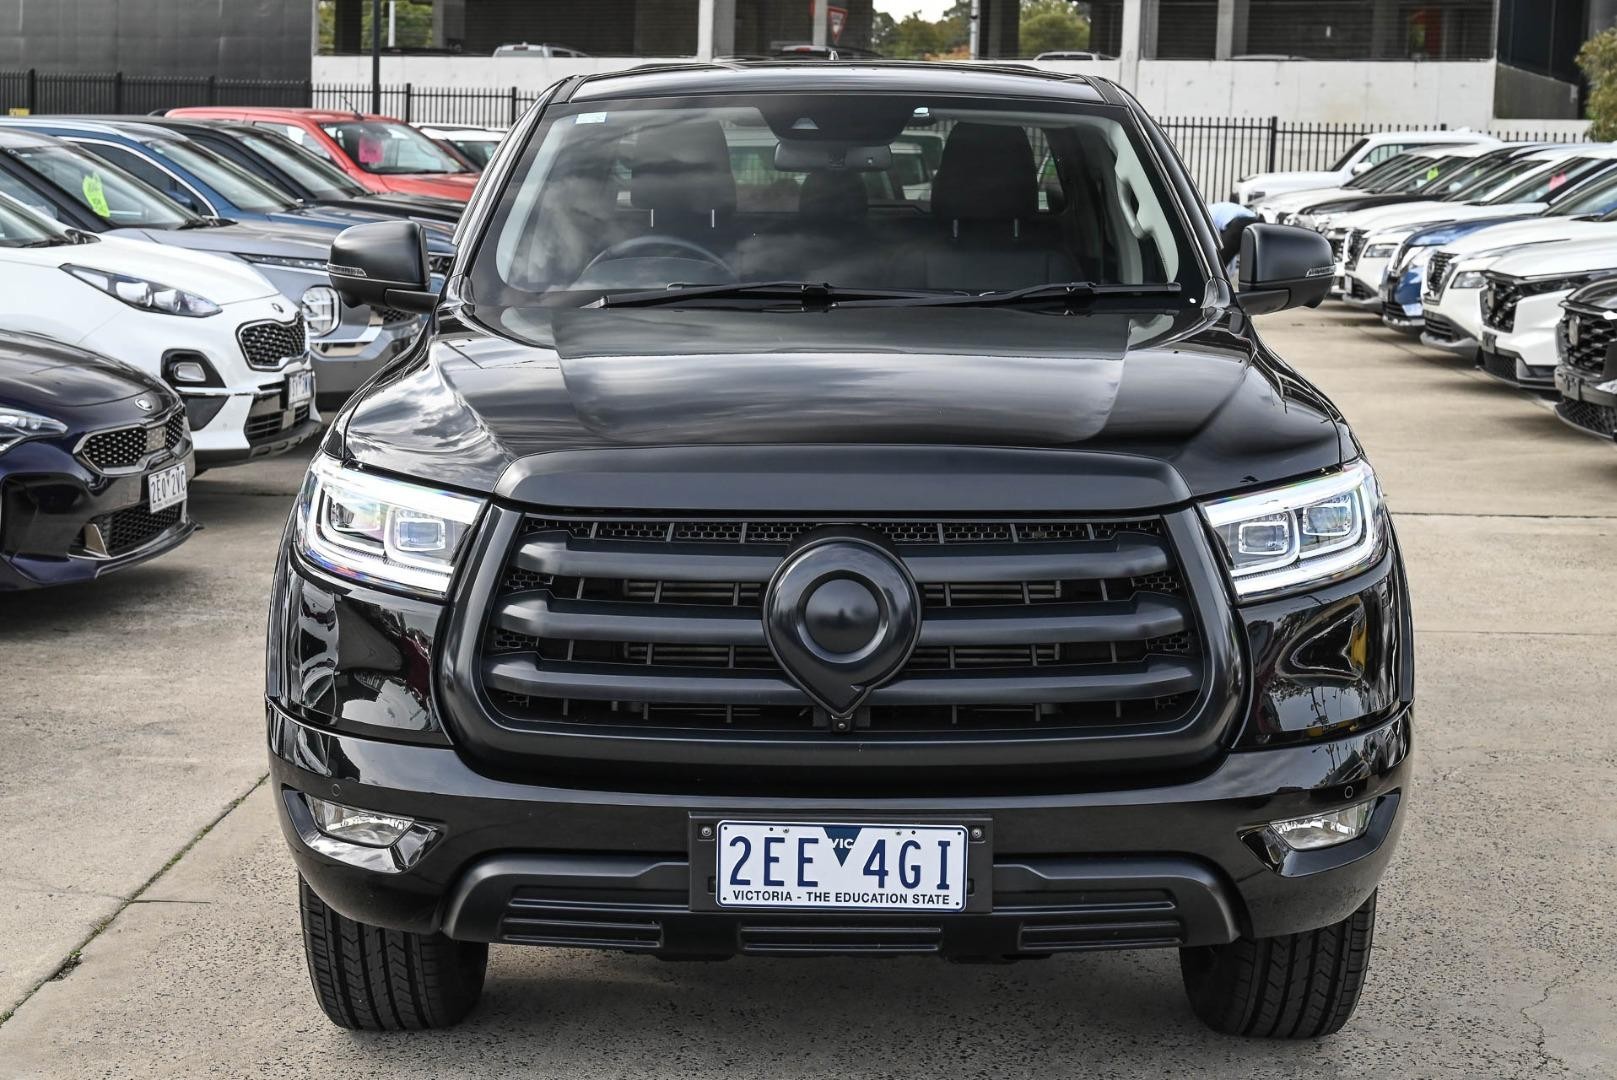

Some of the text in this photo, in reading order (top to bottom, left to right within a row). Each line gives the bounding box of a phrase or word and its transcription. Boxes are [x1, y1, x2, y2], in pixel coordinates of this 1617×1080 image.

[729, 835, 951, 891] 2EE 4GI
[733, 889, 793, 902] VICTORIA
[806, 891, 831, 903] THE
[835, 892, 908, 904] EDUCATION
[912, 893, 950, 905] STATE
